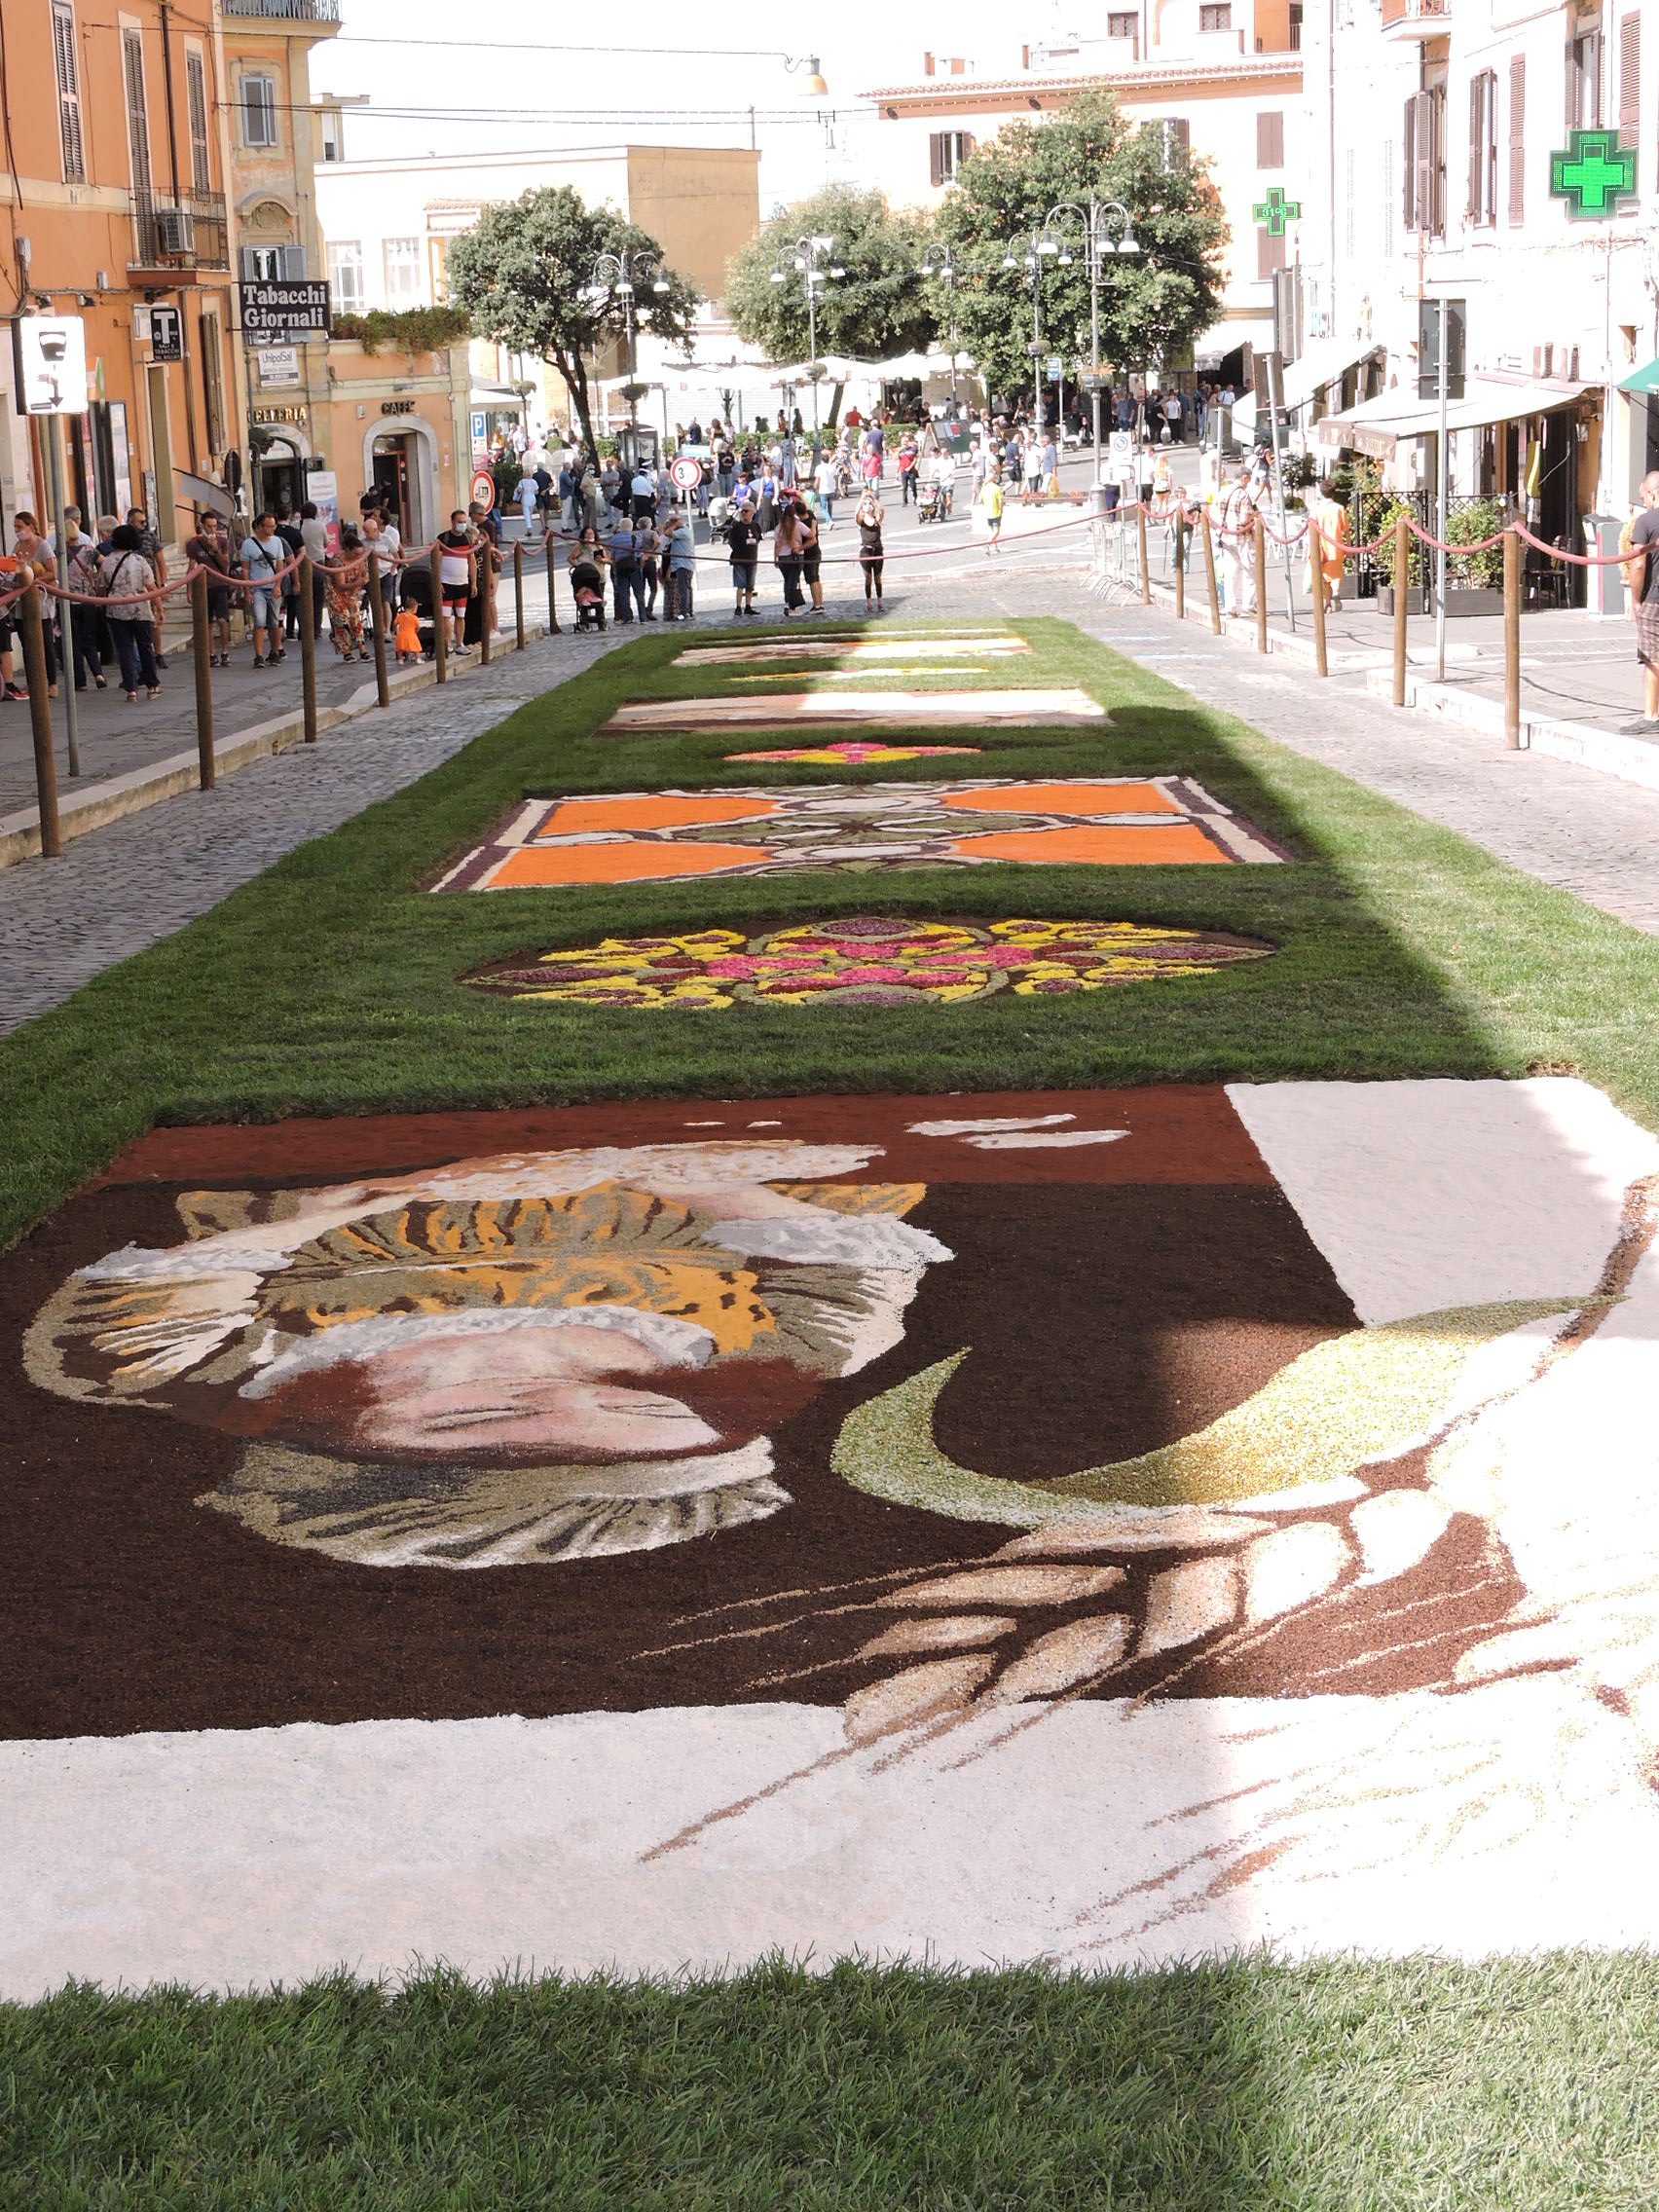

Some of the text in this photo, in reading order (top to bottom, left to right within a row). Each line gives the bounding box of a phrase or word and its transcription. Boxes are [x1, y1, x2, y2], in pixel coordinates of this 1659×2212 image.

[243, 285, 326, 305] Tabacchi
[244, 308, 324, 327] Giornali
[154, 312, 175, 344] T
[474, 417, 483, 435] P
